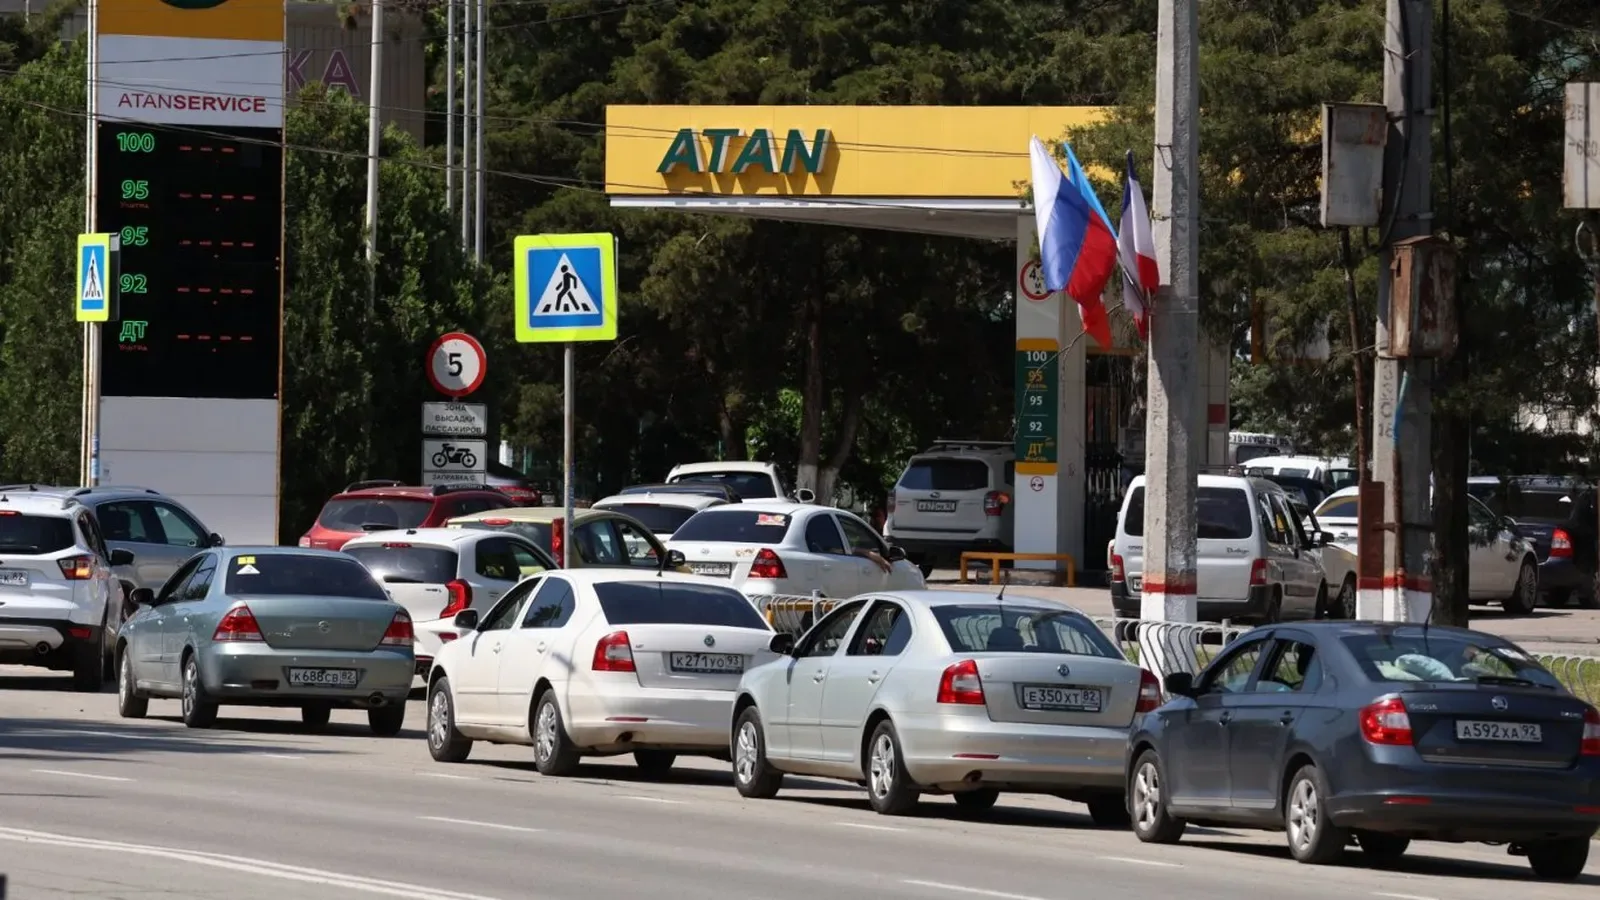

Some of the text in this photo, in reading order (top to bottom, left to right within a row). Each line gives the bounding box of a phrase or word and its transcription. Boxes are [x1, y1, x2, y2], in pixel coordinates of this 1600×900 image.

[118, 93, 267, 113] ATANSERVICE
[116, 132, 155, 152] 100
[657, 127, 831, 174] ATAN
[121, 179, 149, 199] 95
[121, 226, 149, 246] 95
[119, 273, 147, 293] 92
[119, 320, 148, 342] ДТ
[1026, 351, 1047, 362] 100
[448, 353, 462, 376] 5
[1028, 370, 1043, 382] 95
[1029, 395, 1043, 405] 95
[444, 403, 467, 412] ЗОНА
[435, 415, 476, 424] ВЫСАДКИ
[1029, 421, 1043, 431] 92
[425, 424, 482, 434] ПАССАЖИРОВ
[1027, 443, 1044, 456] ДТ
[676, 655, 739, 668] К271УО 93
[294, 671, 353, 683] К688СВ 82
[1029, 689, 1096, 704] Е350ХТ 82
[1463, 723, 1536, 739] А592ХА 92
